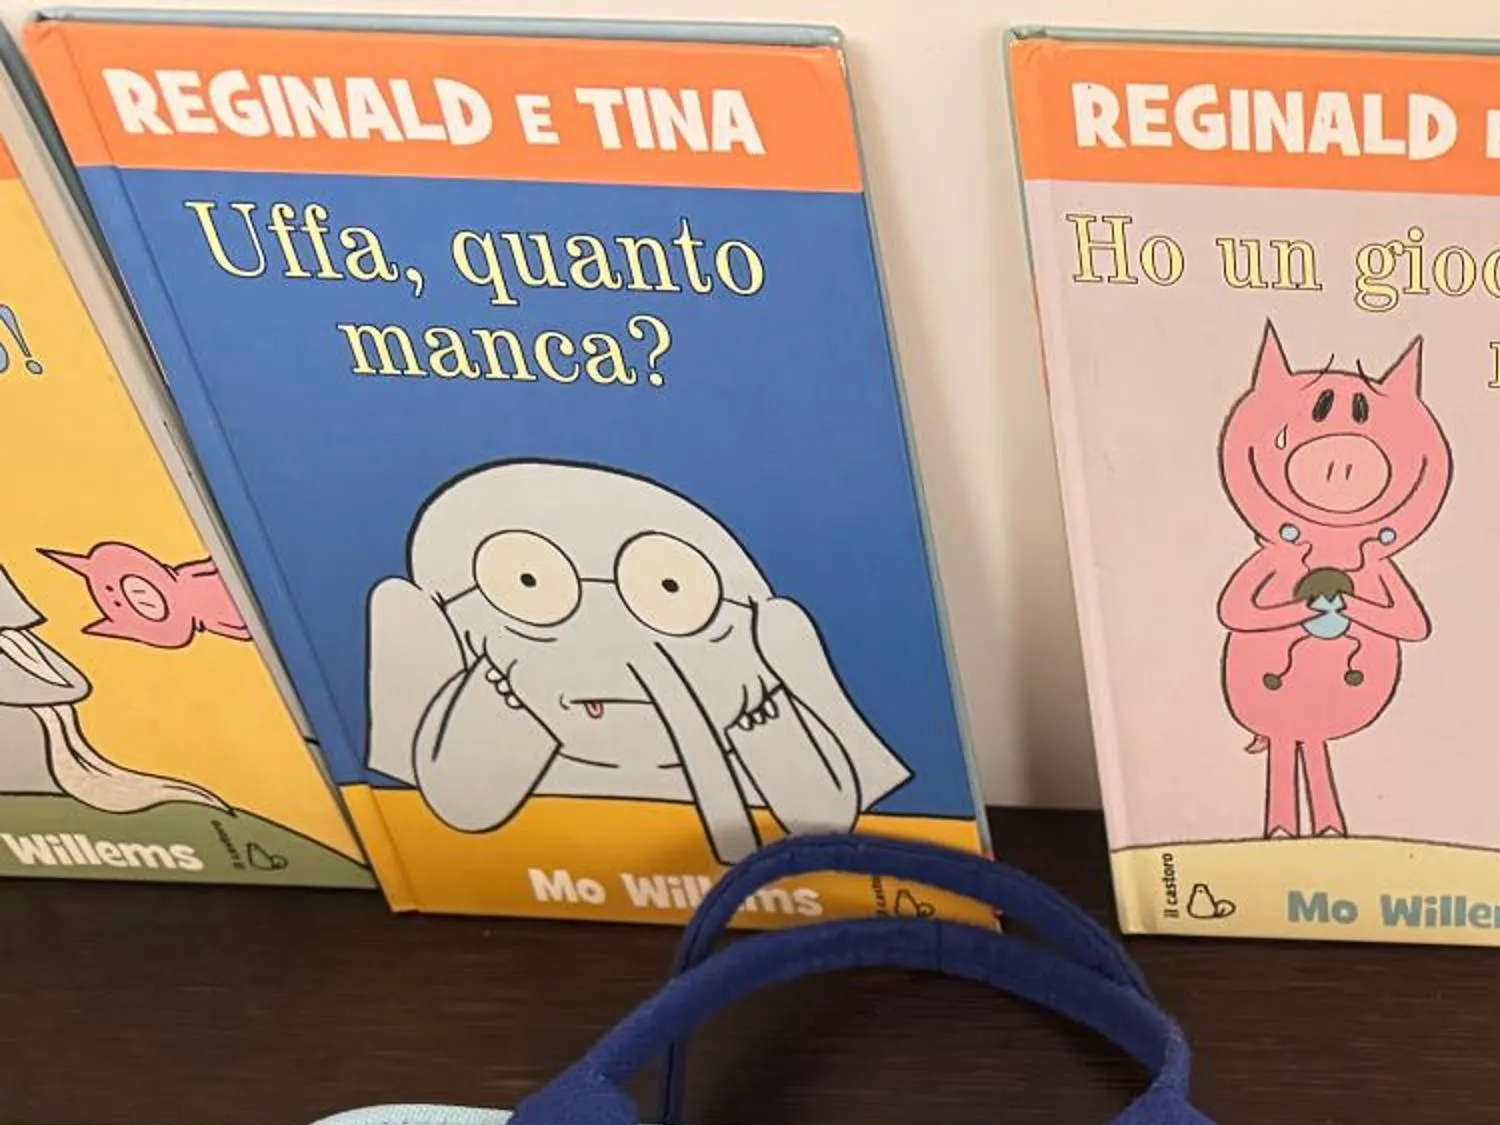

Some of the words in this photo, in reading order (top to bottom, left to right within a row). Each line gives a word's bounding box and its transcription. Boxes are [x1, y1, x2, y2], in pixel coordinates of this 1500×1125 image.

[102, 68, 491, 145] REGINALD
[515, 94, 558, 143] E
[577, 88, 765, 154] TINA
[1071, 82, 1457, 161] REGINALD
[185, 200, 425, 295] Uffa,
[451, 219, 764, 306] quanto
[1067, 213, 1185, 286] Ho
[1217, 236, 1323, 292] un
[339, 315, 673, 387] manca?
[0, 832, 204, 871] Willems
[527, 868, 606, 905] Mo
[1162, 852, 1178, 906] castoro
[1287, 890, 1358, 925] Mo
